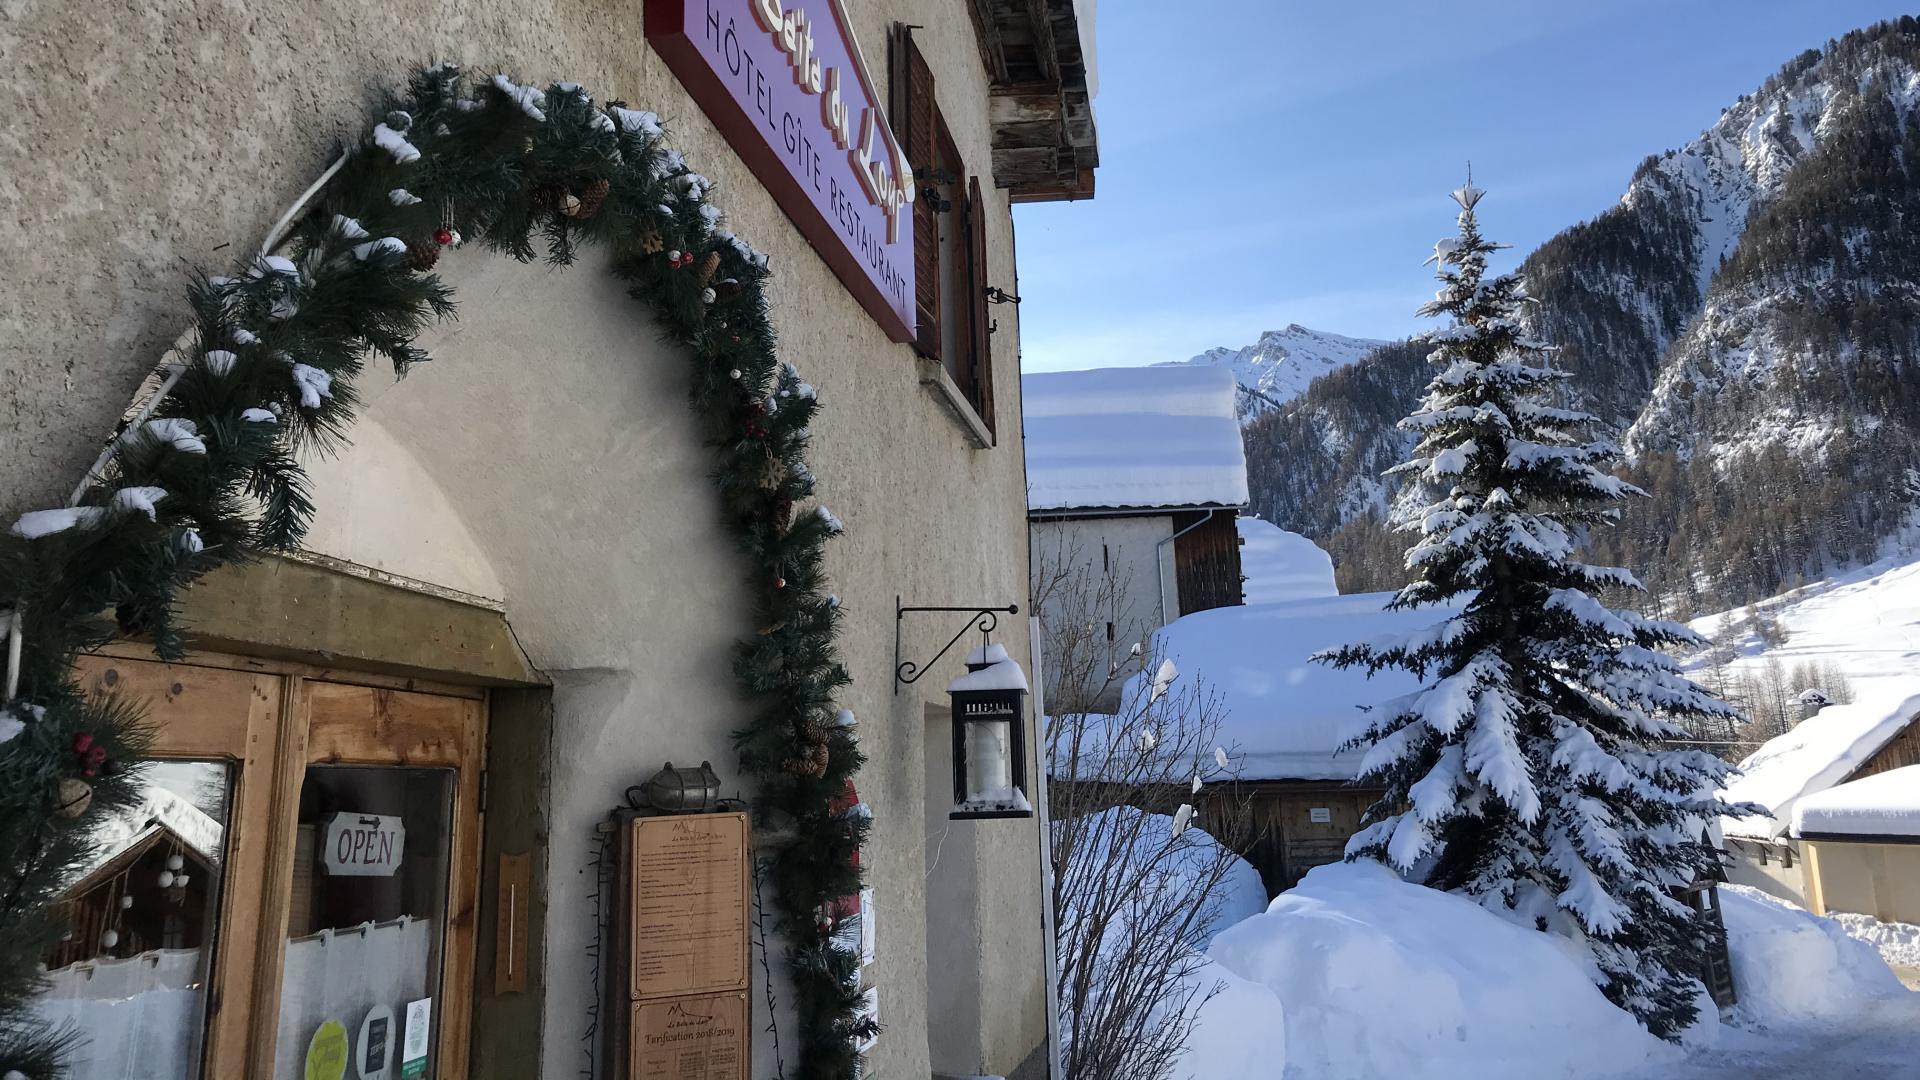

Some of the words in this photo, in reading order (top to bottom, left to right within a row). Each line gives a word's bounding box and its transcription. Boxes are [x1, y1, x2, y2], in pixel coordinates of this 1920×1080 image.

[706, 0, 776, 131] HÔTEL
[783, 111, 821, 193] GÎTE
[830, 177, 906, 309] RESTAURANT
[827, 65, 851, 150] du
[854, 107, 905, 243] Loup
[337, 828, 396, 865] OPEN
[645, 1031, 694, 1046] Tarification
[695, 1027, 735, 1041] 2018/2019
